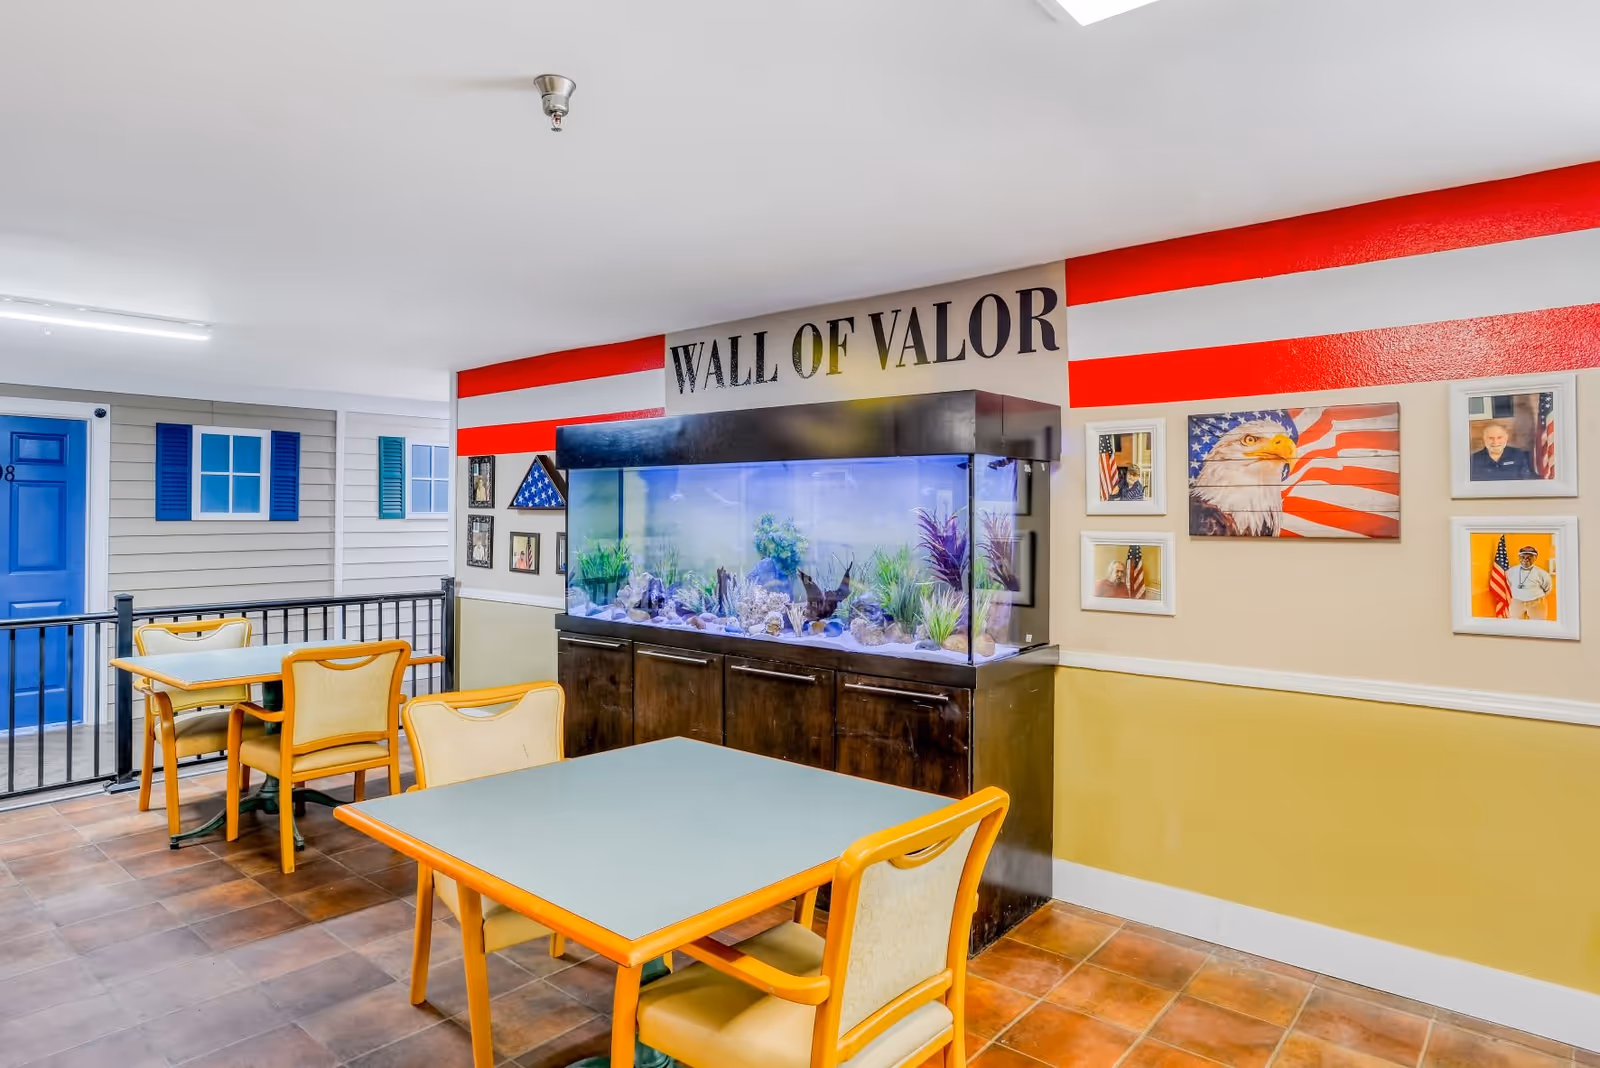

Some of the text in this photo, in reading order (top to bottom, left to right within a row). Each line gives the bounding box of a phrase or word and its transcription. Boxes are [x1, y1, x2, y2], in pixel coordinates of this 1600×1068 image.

[669, 286, 1060, 395] WALL OF VALOR
